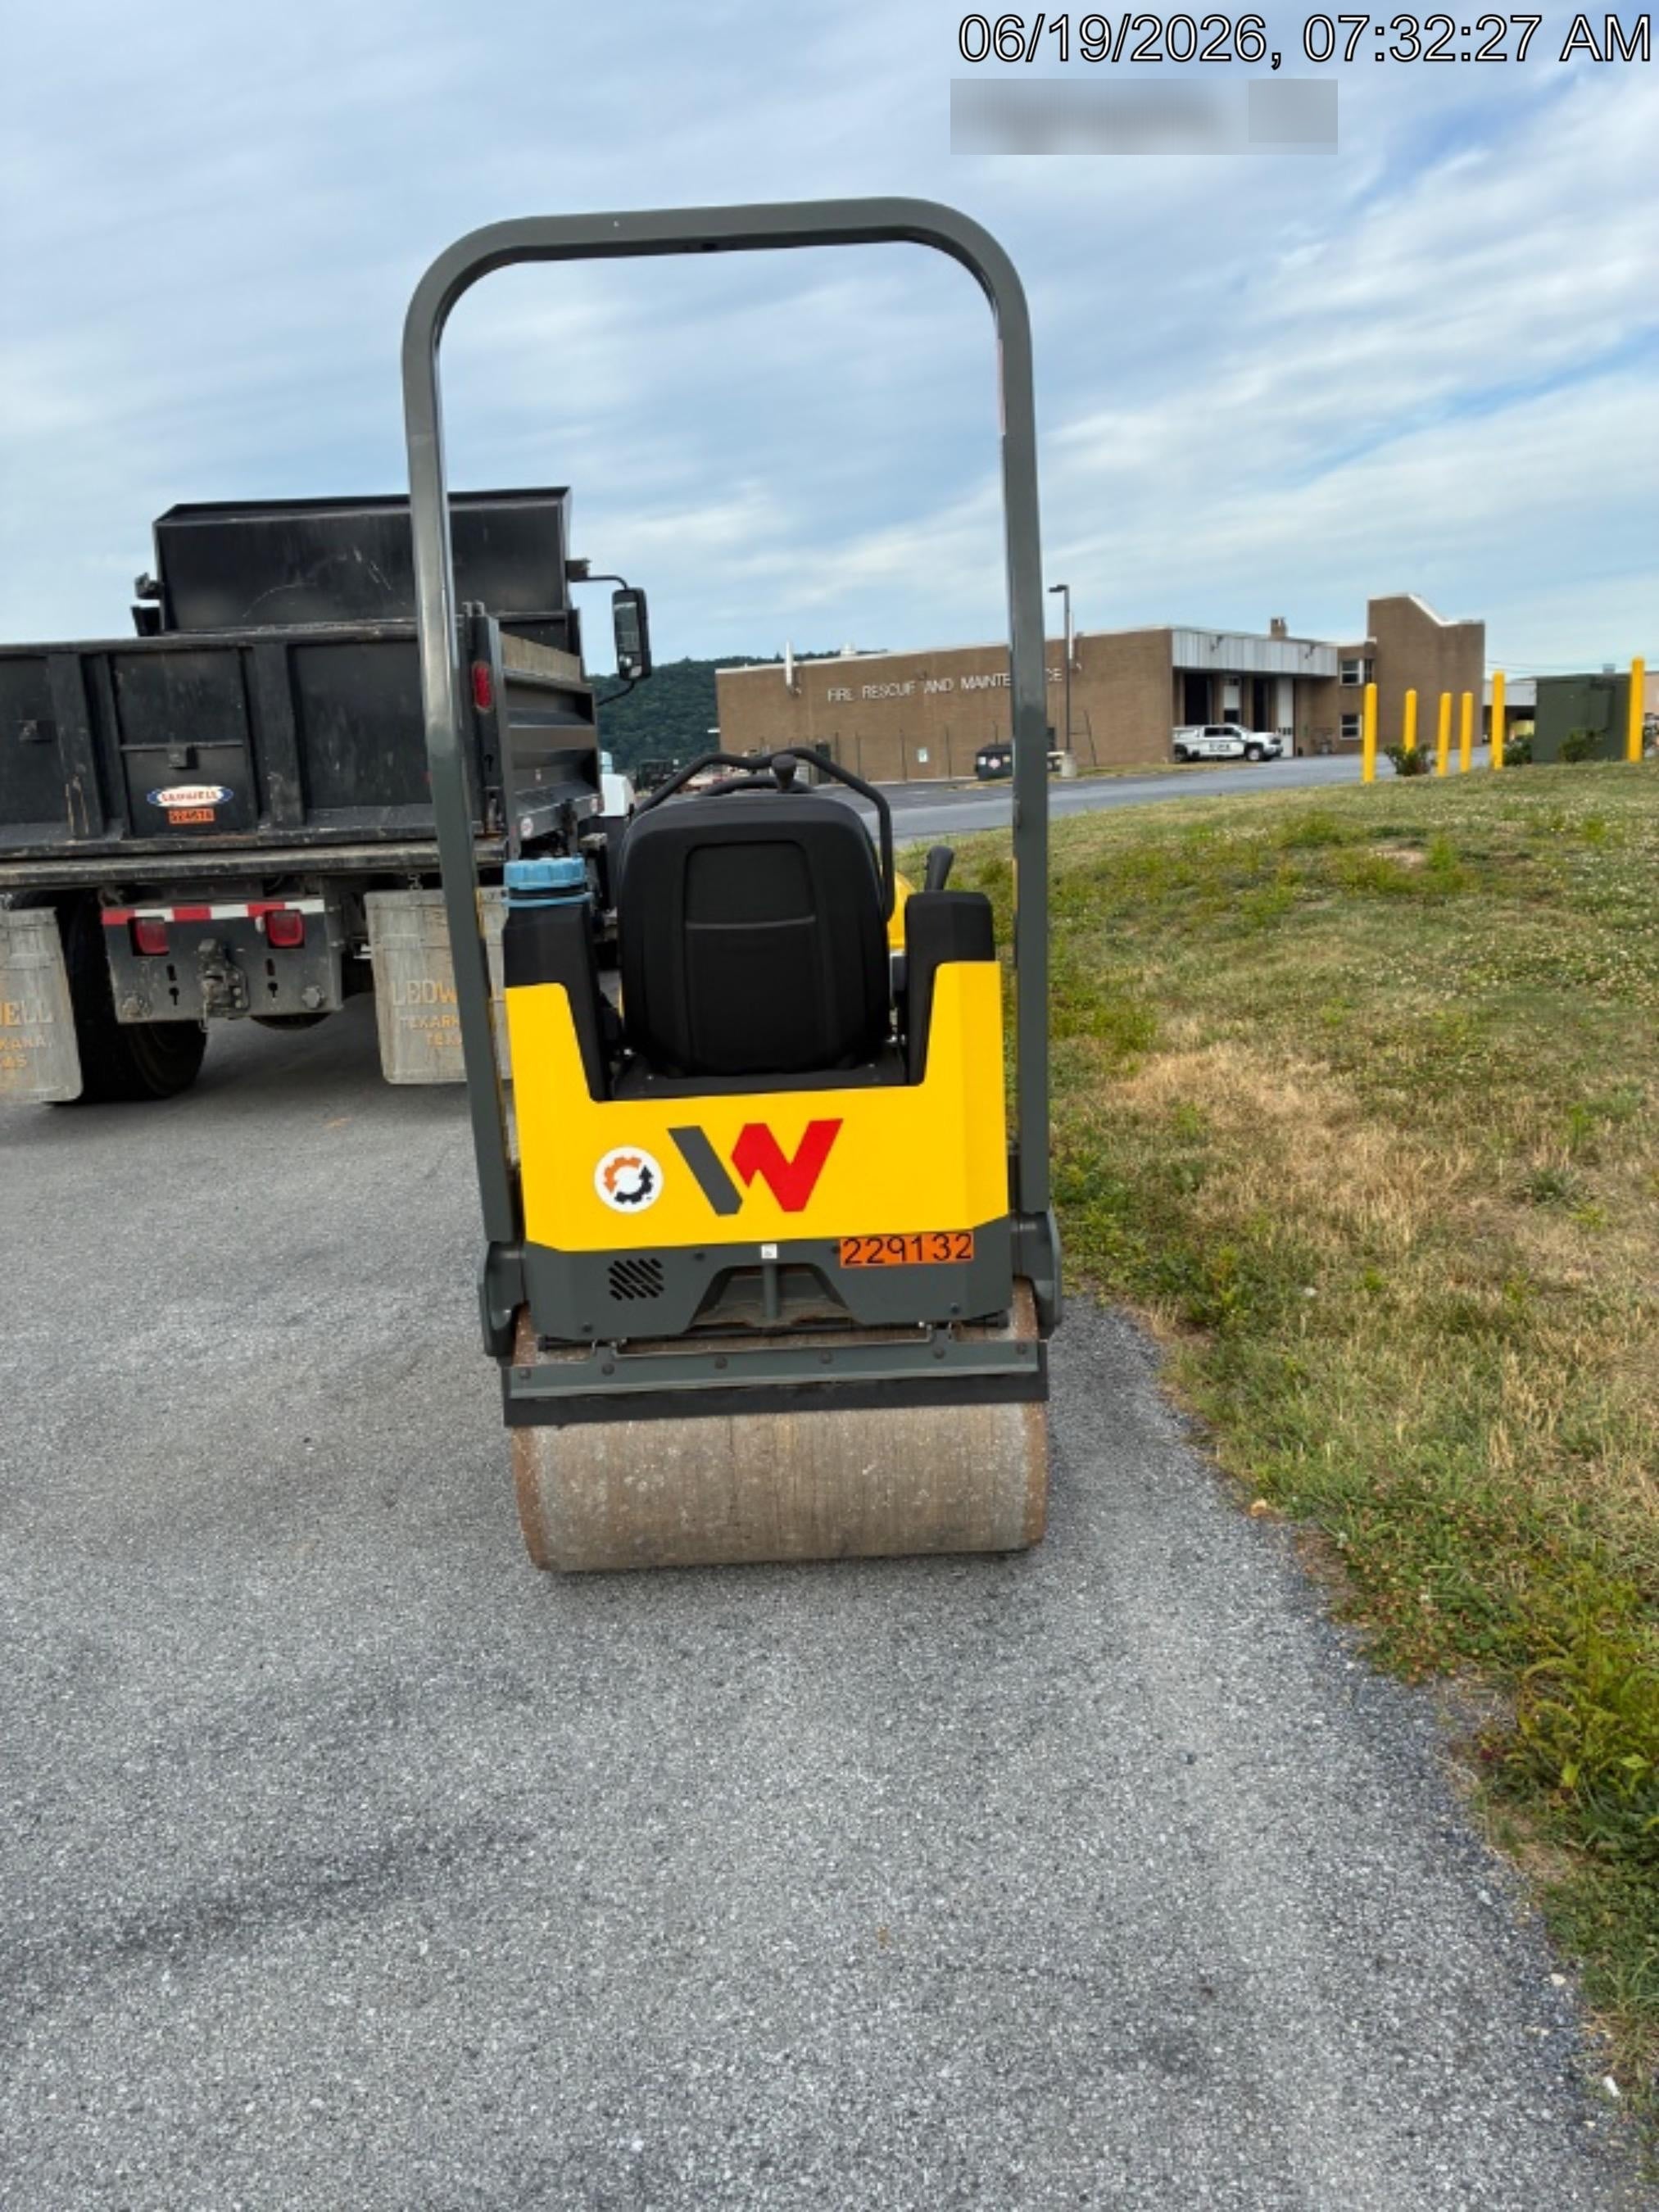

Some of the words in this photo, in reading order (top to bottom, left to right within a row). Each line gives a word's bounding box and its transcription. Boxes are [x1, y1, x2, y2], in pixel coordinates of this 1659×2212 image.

[827, 687, 854, 702] FIRE
[862, 681, 916, 700] RESCUE
[923, 677, 954, 695] AND
[0, 999, 54, 1027] ELL
[842, 1232, 972, 1265] 229132
